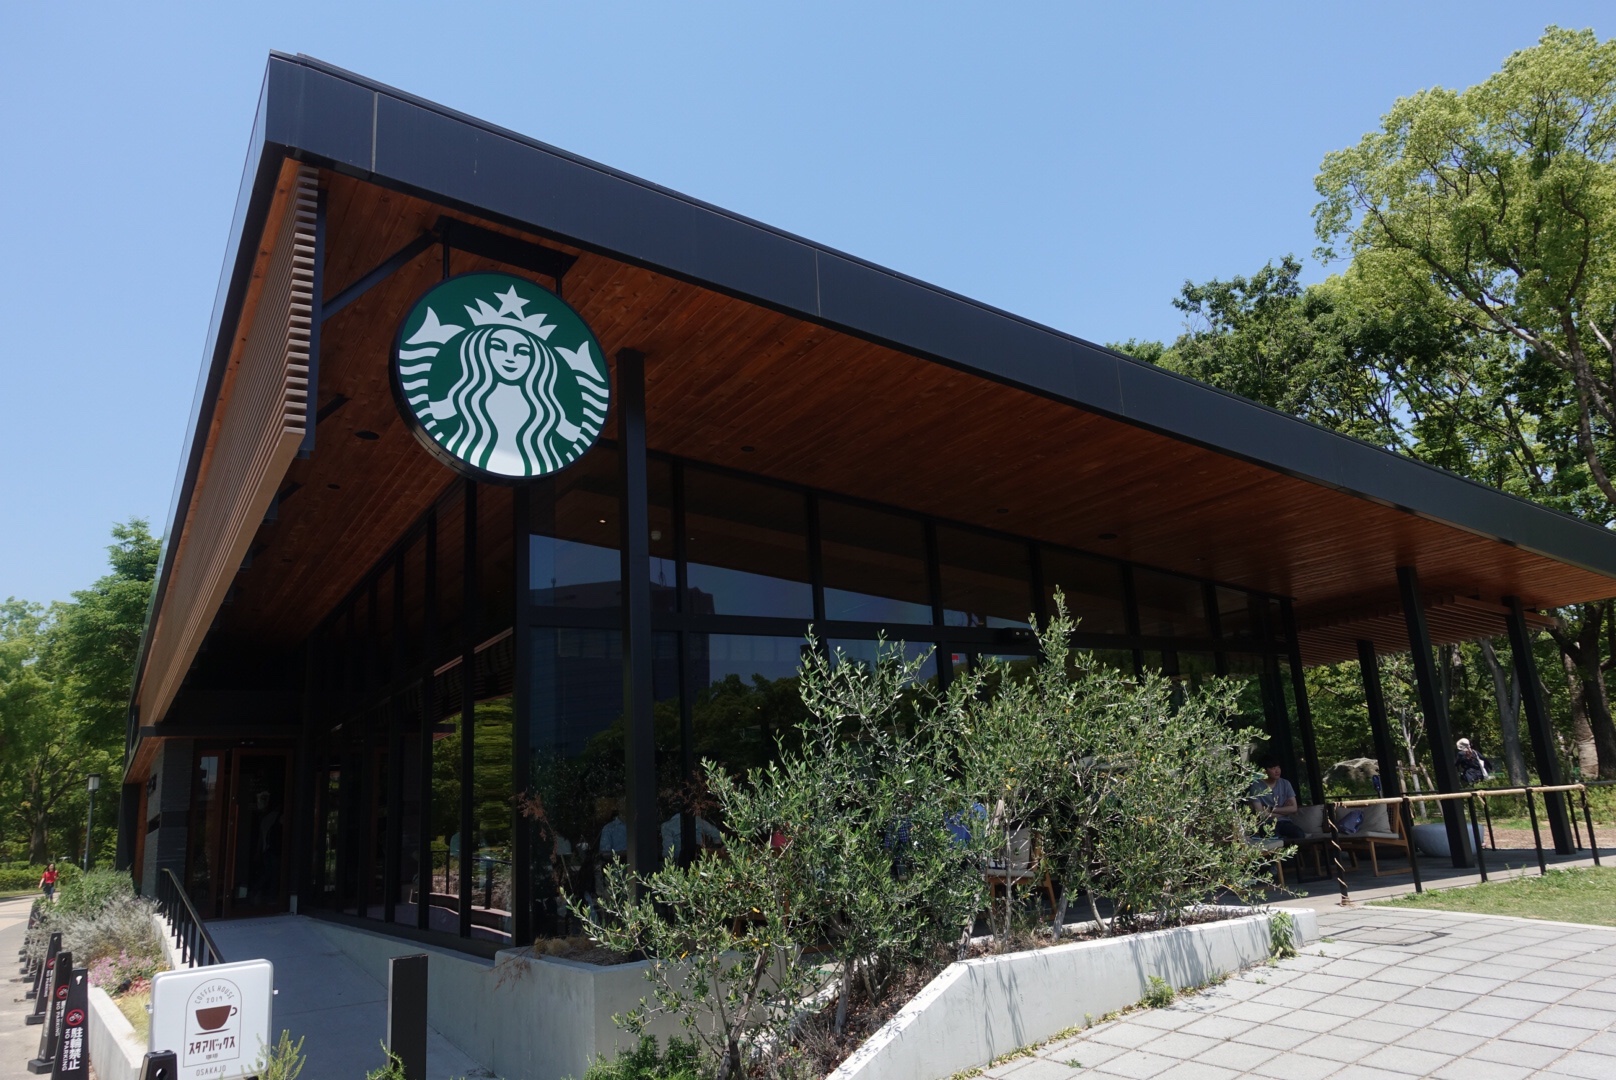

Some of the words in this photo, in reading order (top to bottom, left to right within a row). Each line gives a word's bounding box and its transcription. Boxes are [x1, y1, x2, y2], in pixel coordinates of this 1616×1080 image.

[194, 986, 215, 1004] COFFEE
[217, 986, 234, 1000] HOUSE
[56, 1002, 60, 1013] NO
[65, 1028, 70, 1039] NO
[189, 1036, 235, 1055] スタアバックス
[196, 1065, 226, 1077] OSAKAJO
